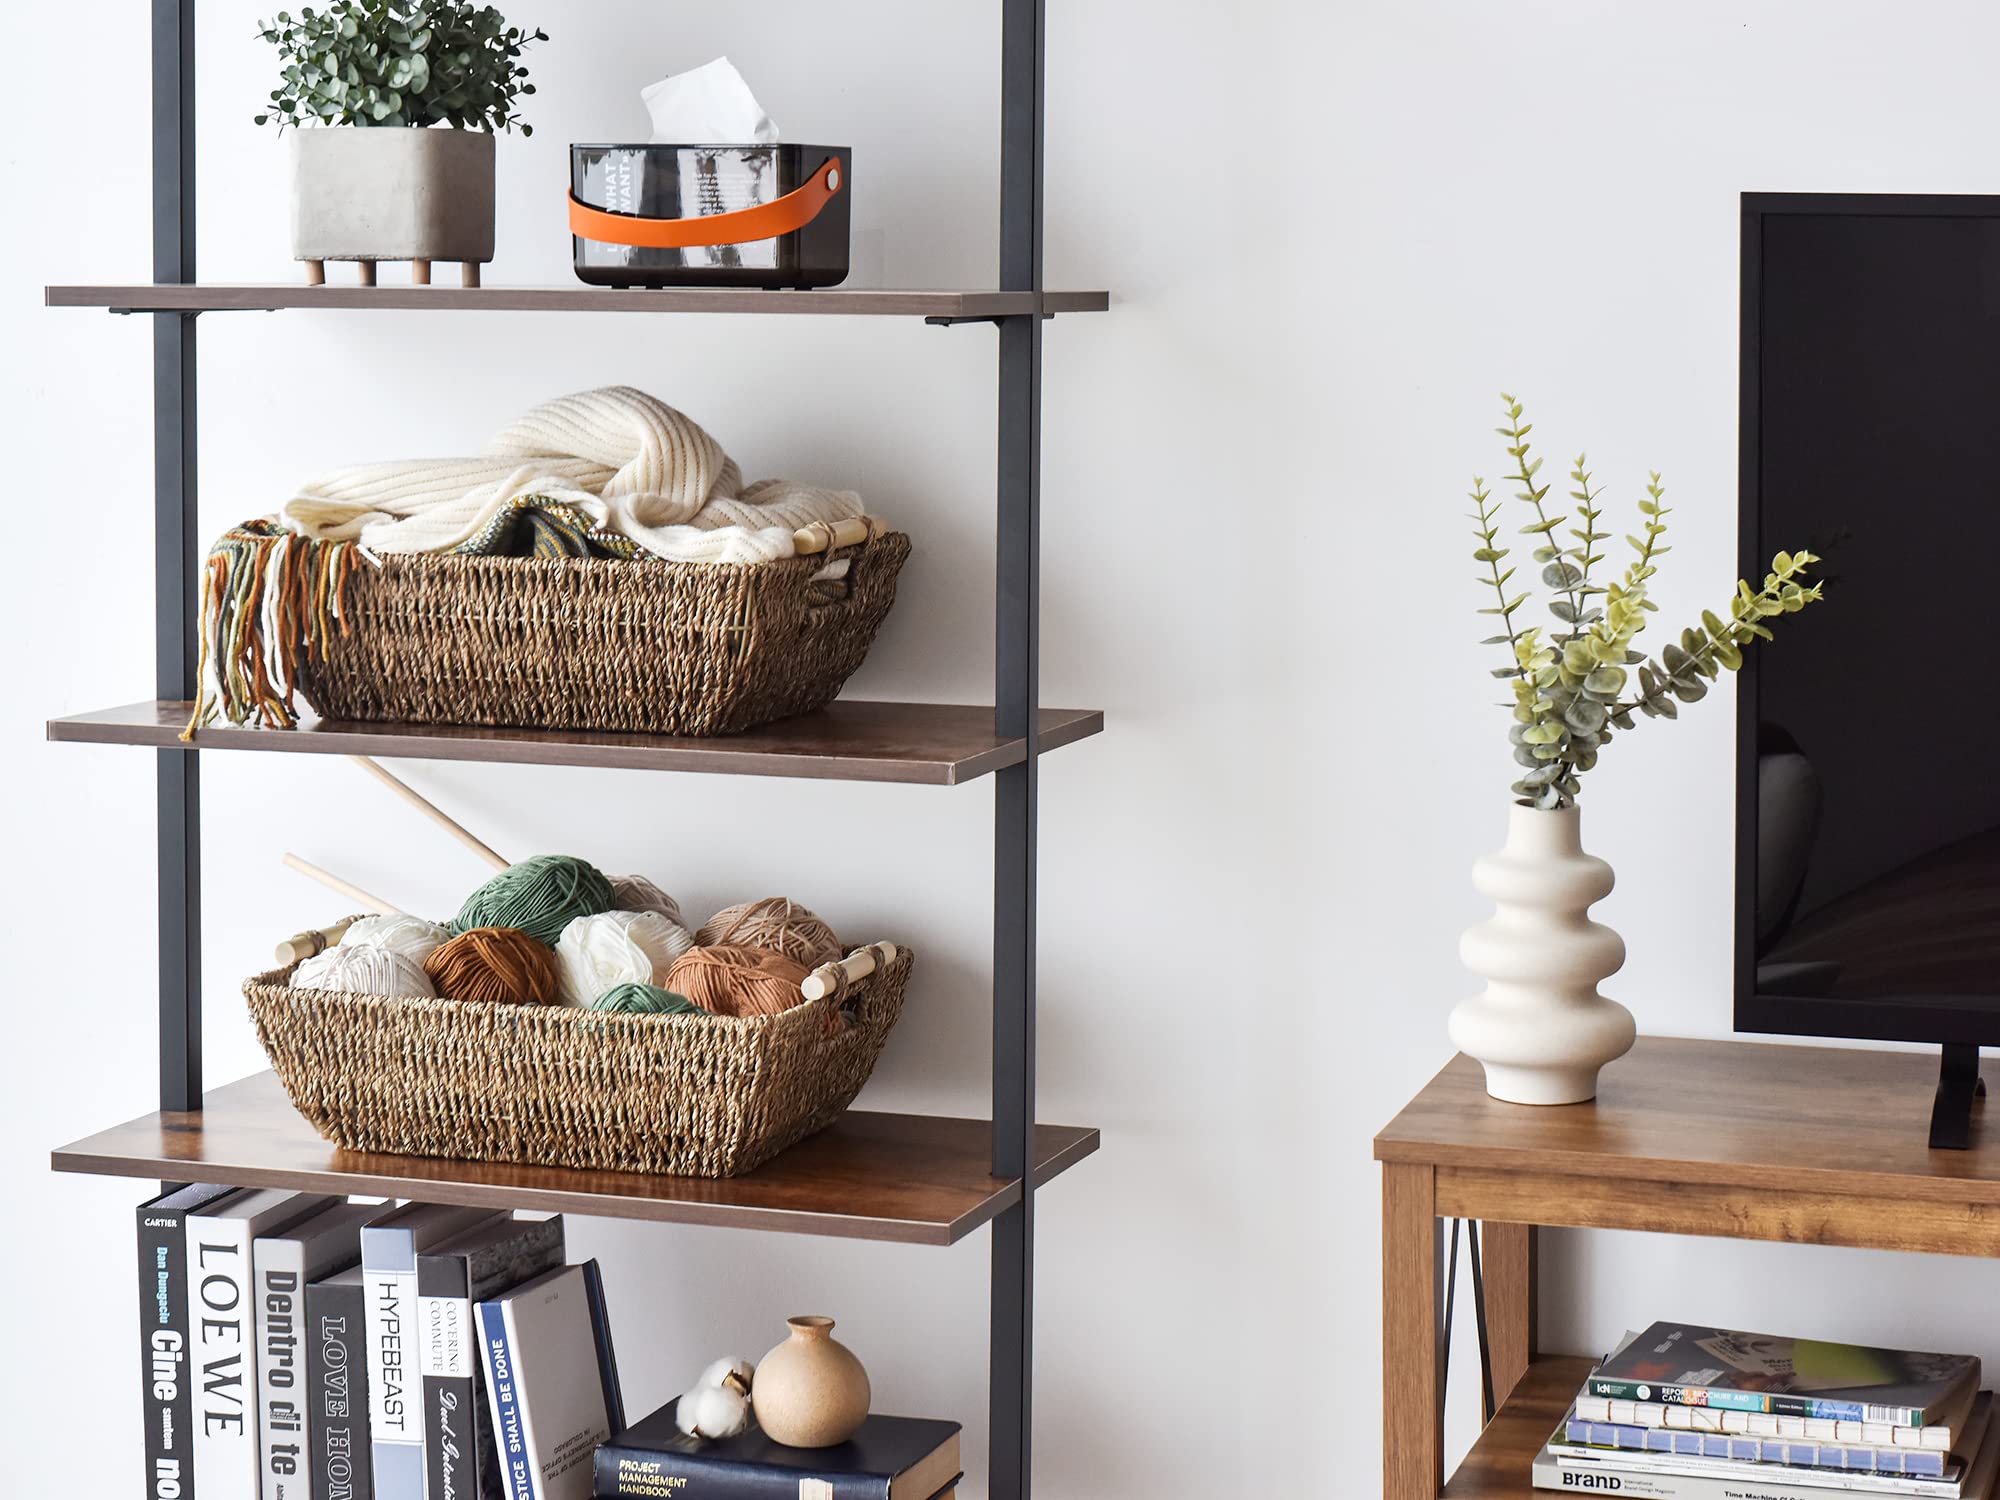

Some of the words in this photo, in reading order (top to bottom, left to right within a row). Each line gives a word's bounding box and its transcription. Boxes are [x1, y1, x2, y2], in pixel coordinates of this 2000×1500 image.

[604, 162, 618, 213] WHAT
[144, 1218, 178, 1228] CARTIER
[156, 1246, 169, 1269] Dan
[156, 1271, 170, 1324] Dungaciu
[199, 1241, 244, 1438] LOEWE
[265, 1270, 298, 1388] Dentro
[430, 1301, 443, 1372] COMMUTE
[446, 1301, 459, 1373] COVERING
[151, 1329, 184, 1401] Cine
[321, 1316, 349, 1417] LOVE
[378, 1282, 404, 1432] HYPEBEAST
[492, 1339, 509, 1380] DONE
[500, 1383, 512, 1403] BE
[1597, 1383, 1611, 1394] IdN
[1661, 1395, 1707, 1406] CATALOGUE
[1693, 1390, 1731, 1401] BROCHURE
[269, 1401, 301, 1432] di
[502, 1406, 522, 1453] SHALL
[553, 1432, 584, 1454] COLORADO
[270, 1443, 301, 1475] te
[542, 1456, 562, 1473] OFFICE
[618, 1460, 661, 1474] PROJECT
[155, 1458, 181, 1500] no
[547, 1470, 559, 1480] THE
[618, 1472, 687, 1488] MANAGEMENT
[618, 1483, 672, 1498] HANDBOOK
[1724, 1491, 1743, 1499] Time
